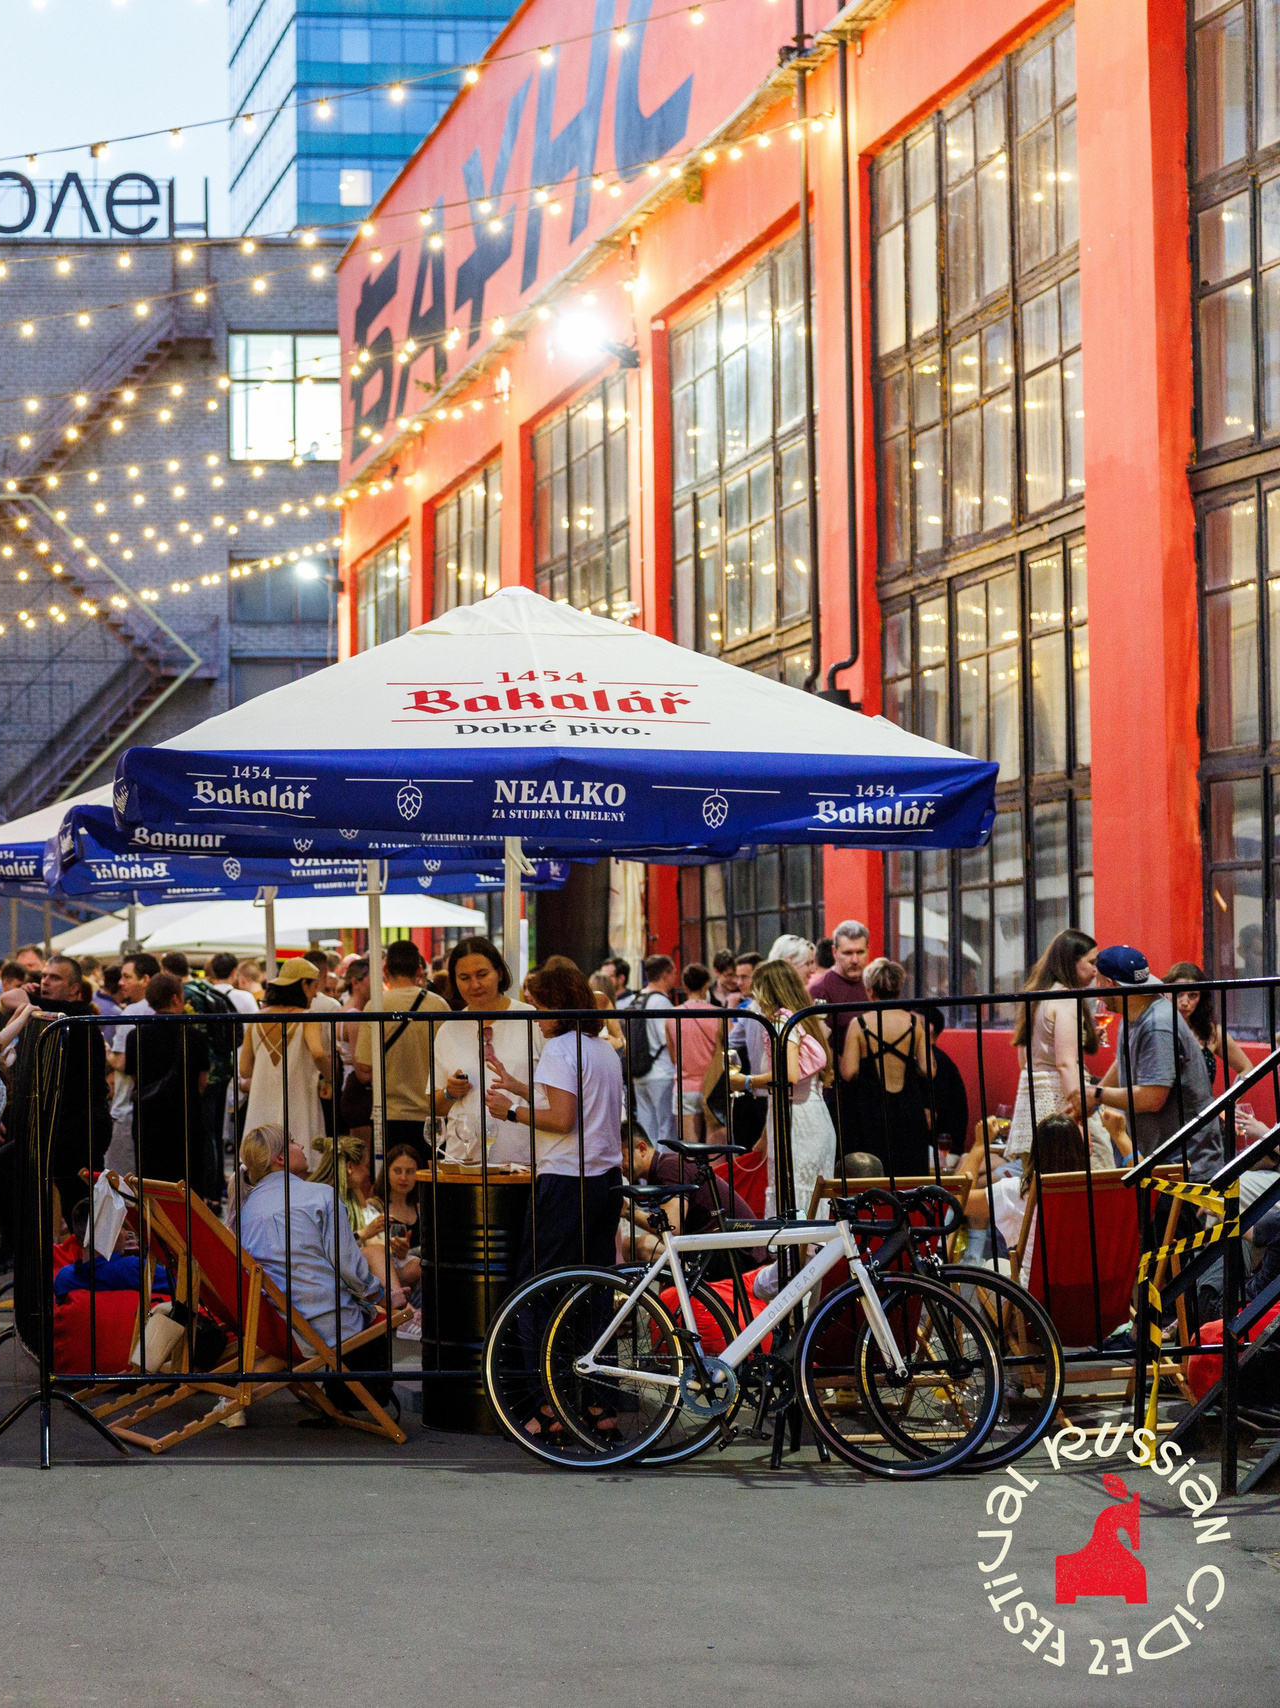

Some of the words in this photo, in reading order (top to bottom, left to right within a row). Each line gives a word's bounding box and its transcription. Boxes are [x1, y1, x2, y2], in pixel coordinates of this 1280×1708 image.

[496, 670, 587, 684] 1454
[402, 687, 691, 714] Bakalář
[455, 720, 557, 735] Dobré
[567, 722, 651, 737] pivo.
[232, 766, 271, 779] 1454
[193, 780, 311, 810] Bakalář
[493, 780, 626, 807] NEALKO
[855, 785, 895, 797] 1454
[492, 809, 505, 818] ZA
[509, 809, 560, 819] STUDENA
[564, 810, 626, 822] CHMELENÝ
[812, 800, 935, 826] Bakalář
[767, 1266, 816, 1320] OUTLEAP
